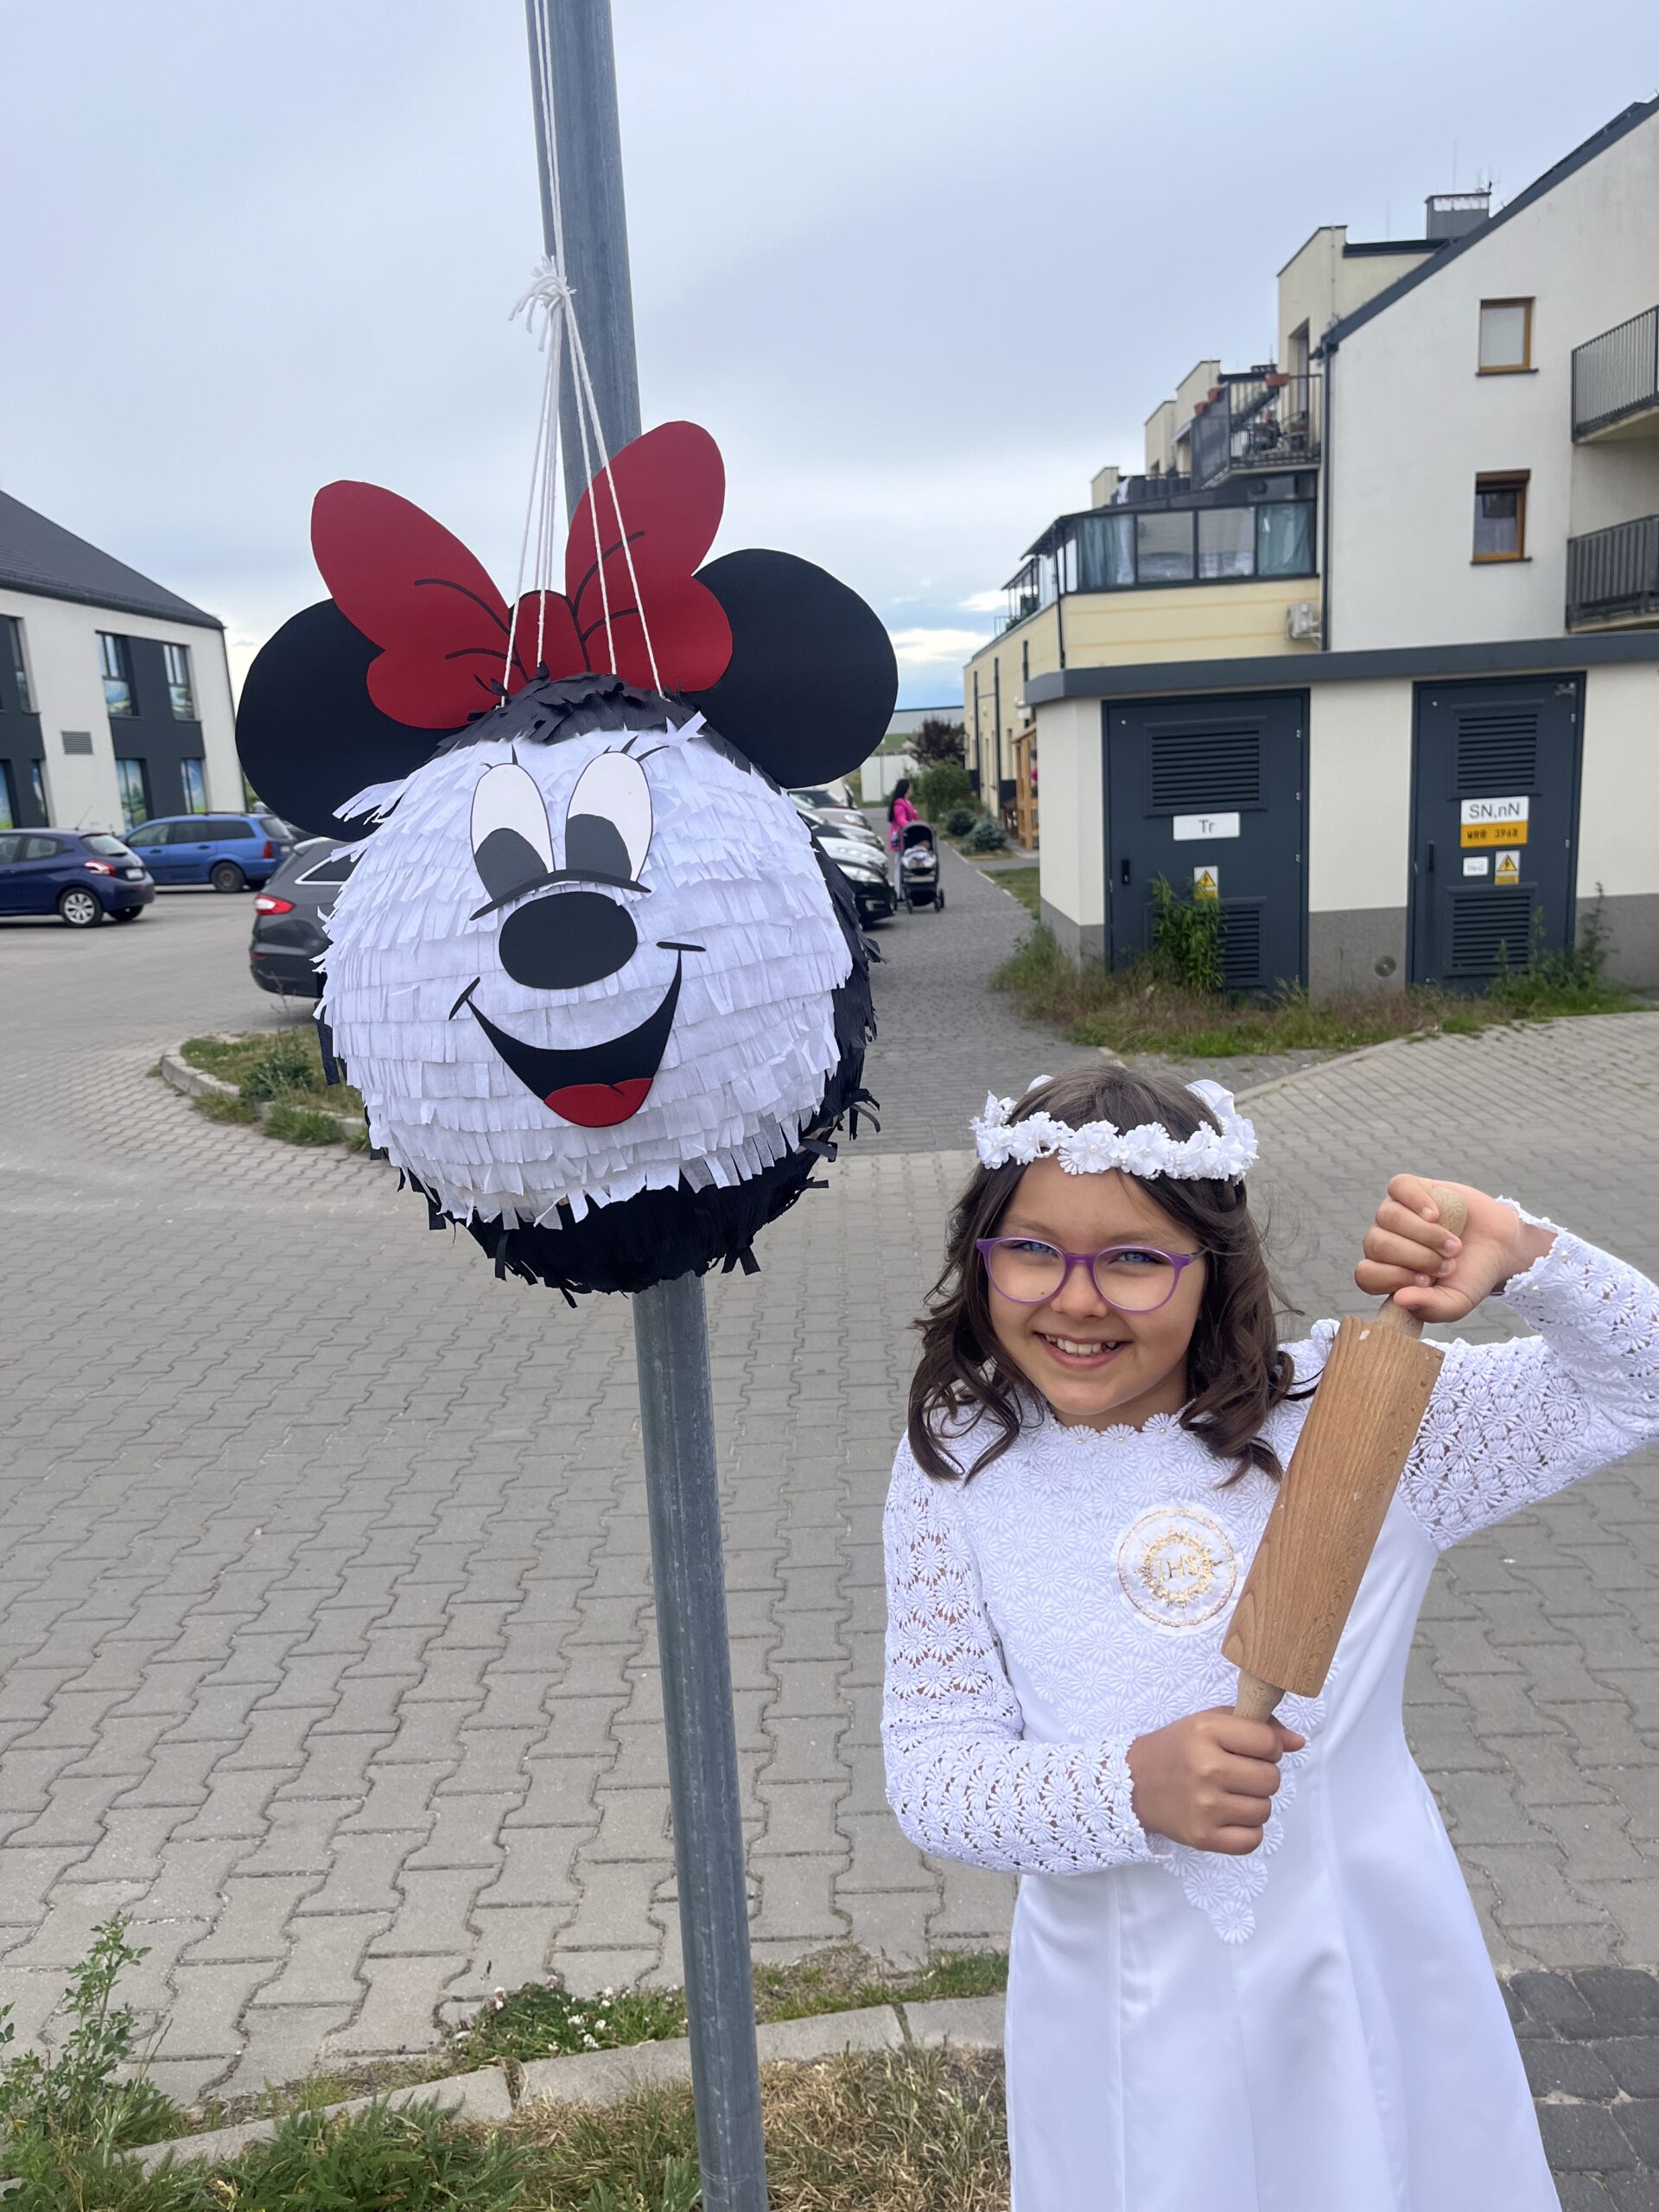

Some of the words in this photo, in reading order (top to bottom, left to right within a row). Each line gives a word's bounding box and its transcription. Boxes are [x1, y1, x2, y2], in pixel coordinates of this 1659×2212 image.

[1469, 801, 1520, 819] SN,nN
[1198, 819, 1215, 833] Tr
[1156, 1555, 1199, 1582] IHS
